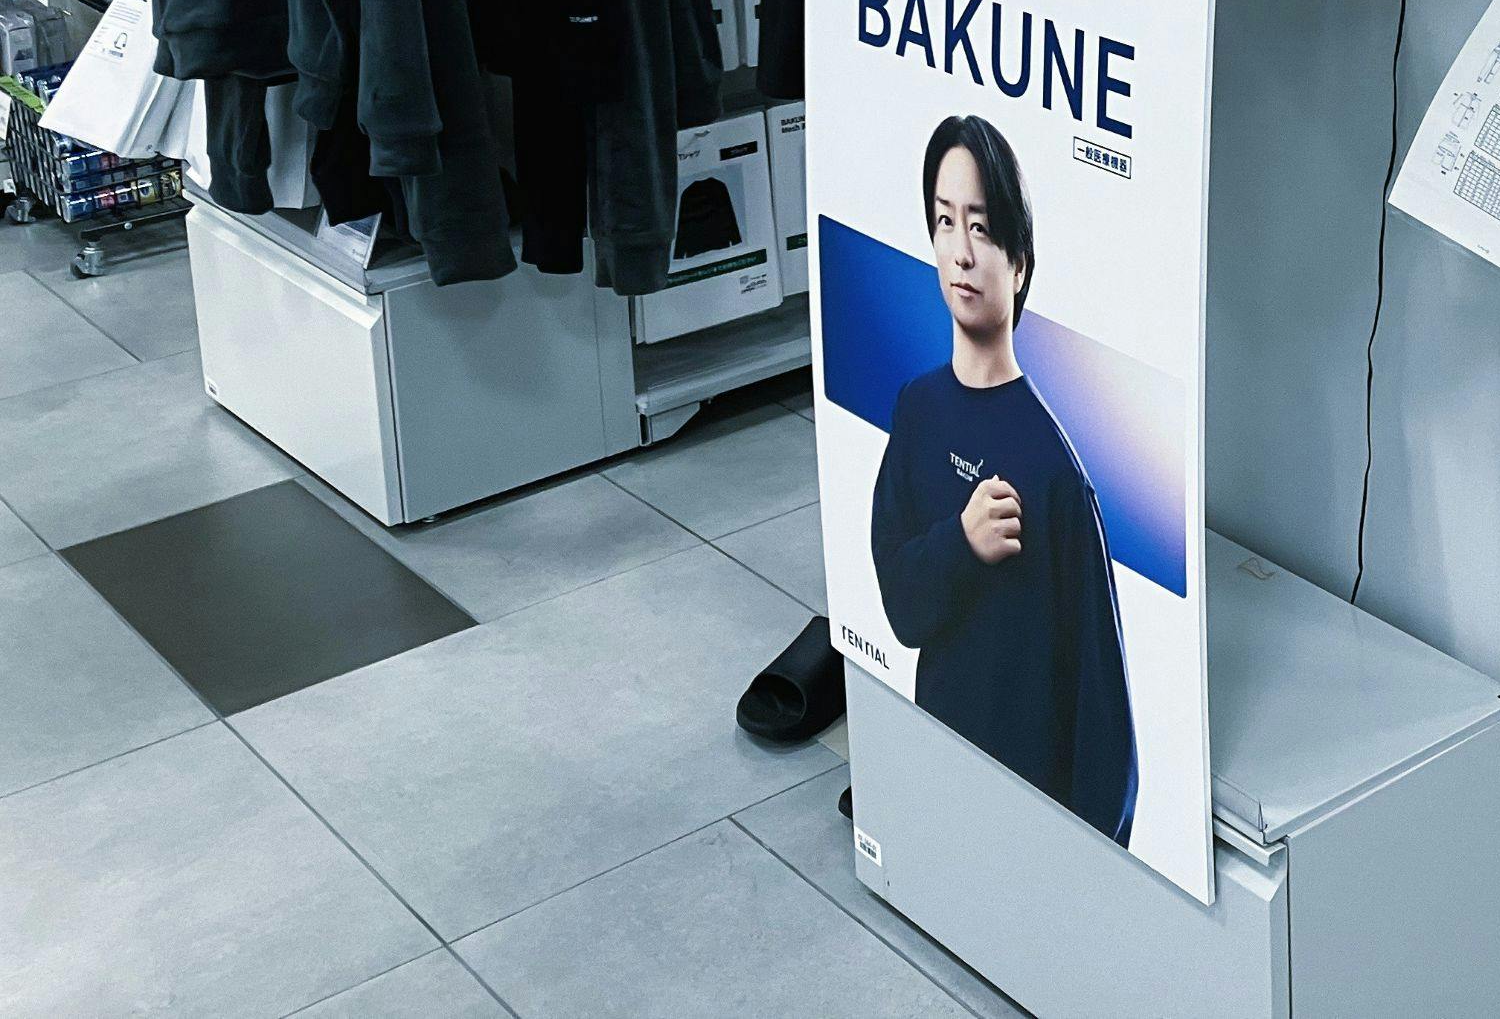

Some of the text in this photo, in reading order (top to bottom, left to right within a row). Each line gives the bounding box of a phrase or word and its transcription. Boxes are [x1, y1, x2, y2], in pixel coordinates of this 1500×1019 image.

[781, 114, 806, 127] BAKUN
[1076, 146, 1129, 175] 一般医療機器
[950, 452, 983, 477] TENTIAL
[840, 624, 891, 670] TENTIAL
